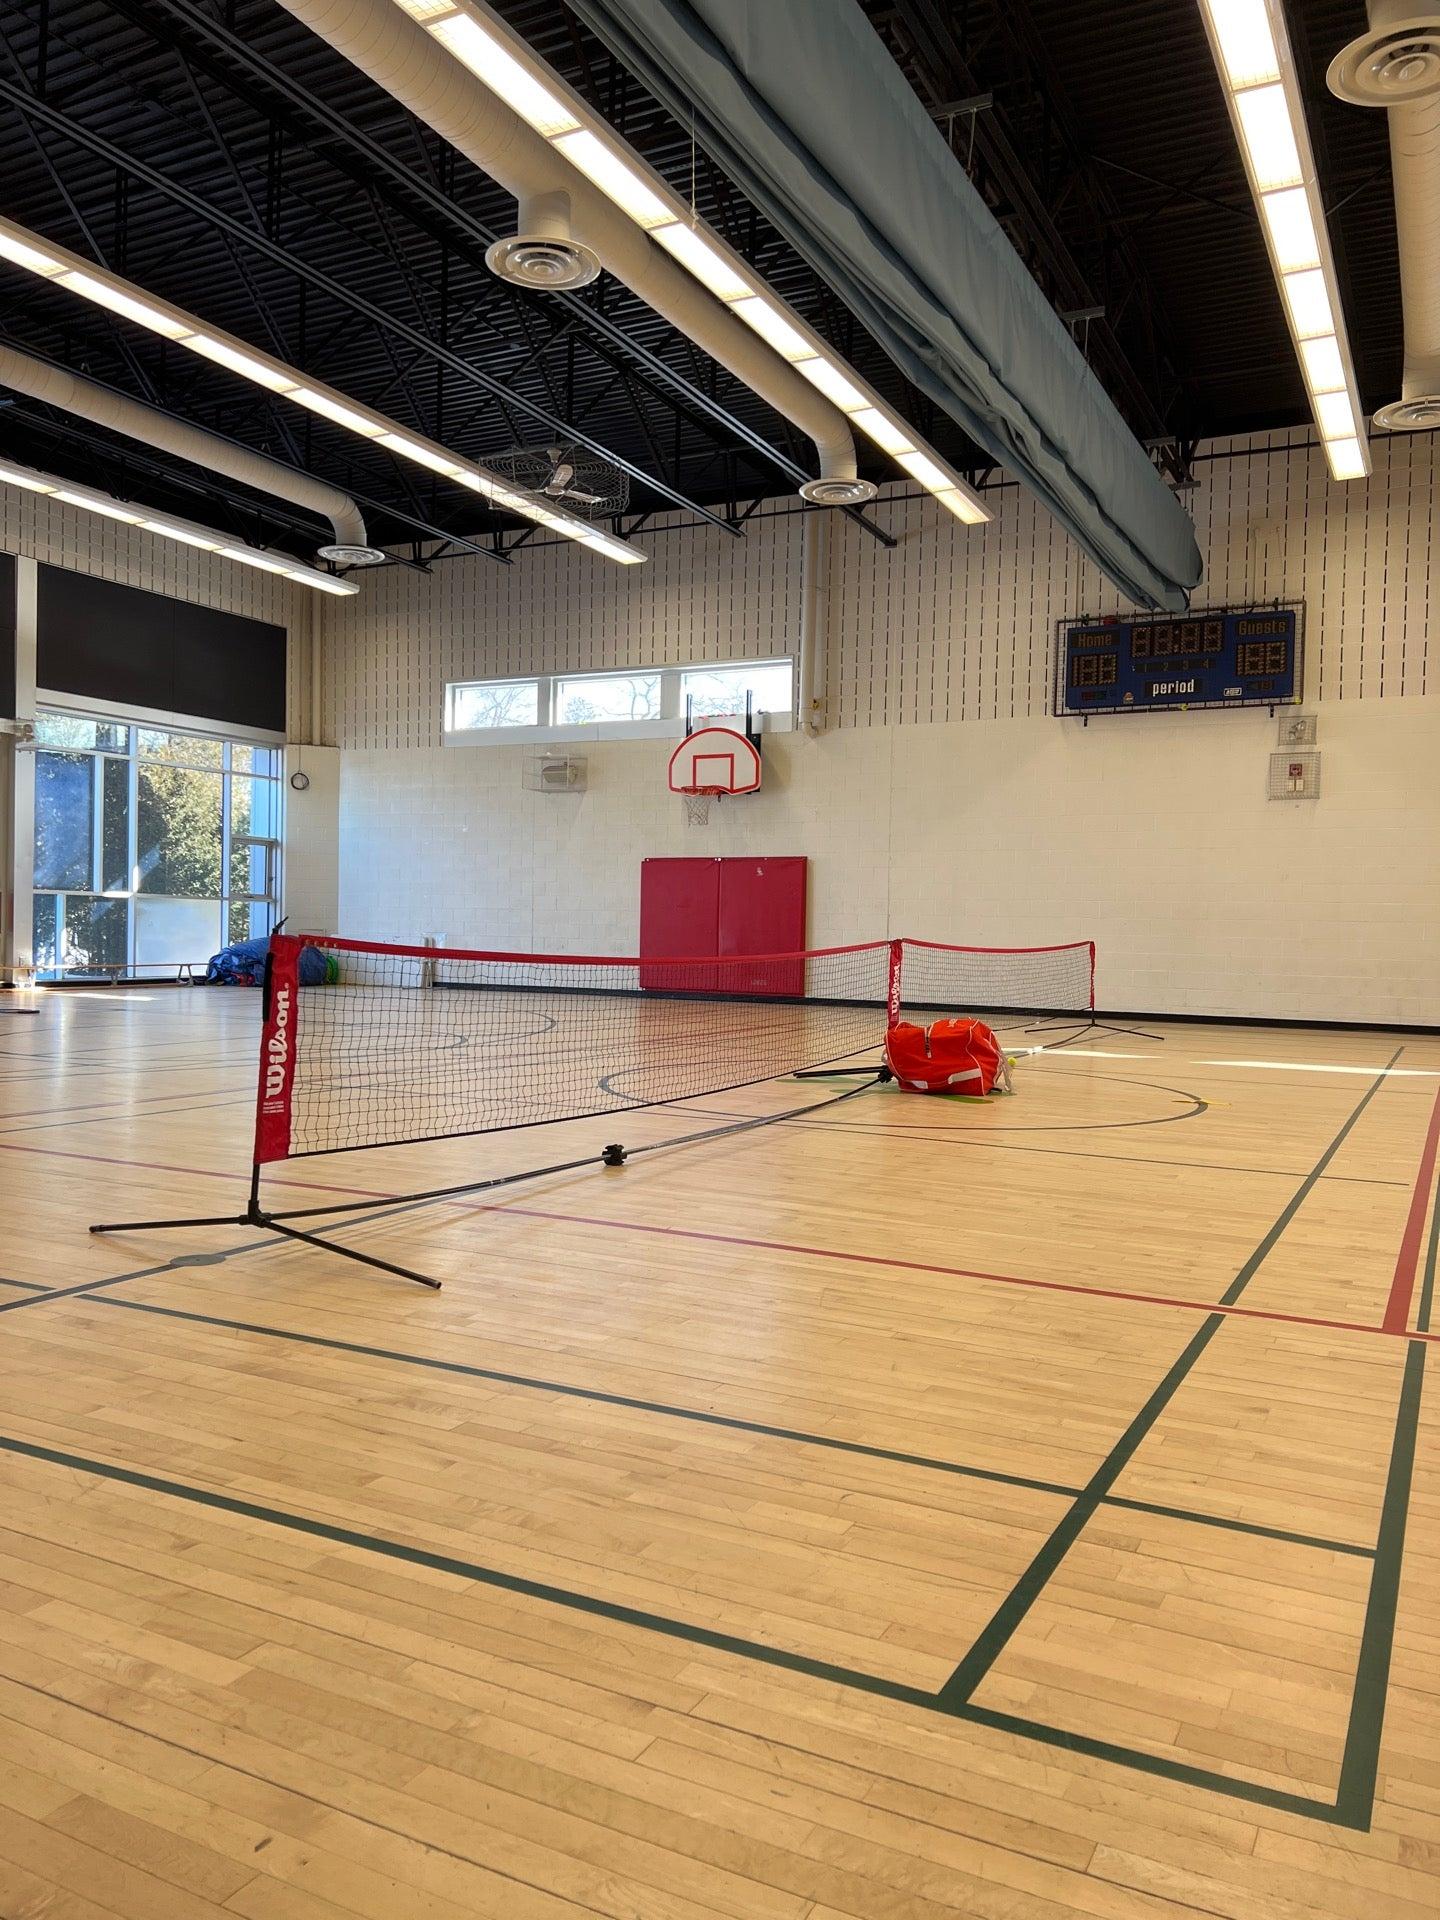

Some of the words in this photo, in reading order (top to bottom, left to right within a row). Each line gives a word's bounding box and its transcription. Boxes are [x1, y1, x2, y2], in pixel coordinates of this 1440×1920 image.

[1239, 620, 1287, 635] Guests
[1077, 632, 1112, 648] Home
[1152, 678, 1195, 697] period
[891, 964, 900, 1015] Wilson
[265, 989, 290, 1099] Wilson
